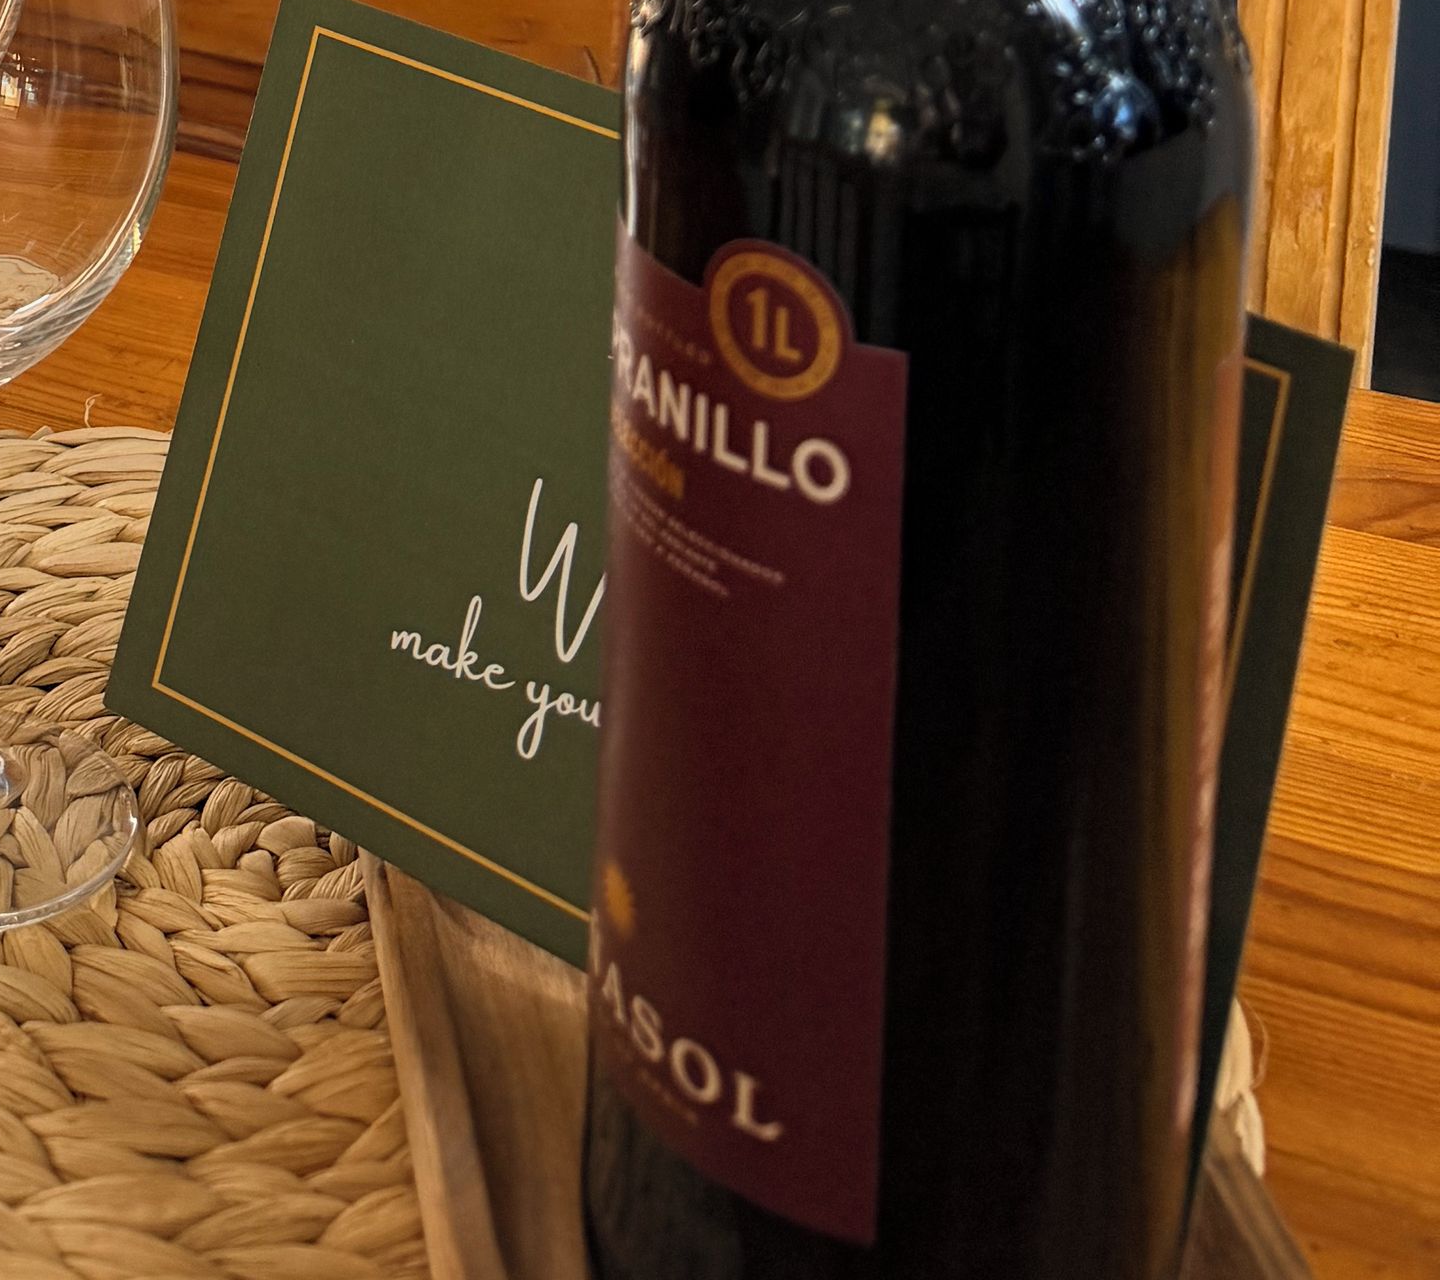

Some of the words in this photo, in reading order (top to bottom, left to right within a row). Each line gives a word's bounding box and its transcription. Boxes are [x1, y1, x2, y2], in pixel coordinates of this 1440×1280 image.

[613, 312, 851, 504] RANILLO
[391, 596, 515, 690] make
[519, 477, 607, 663] W
